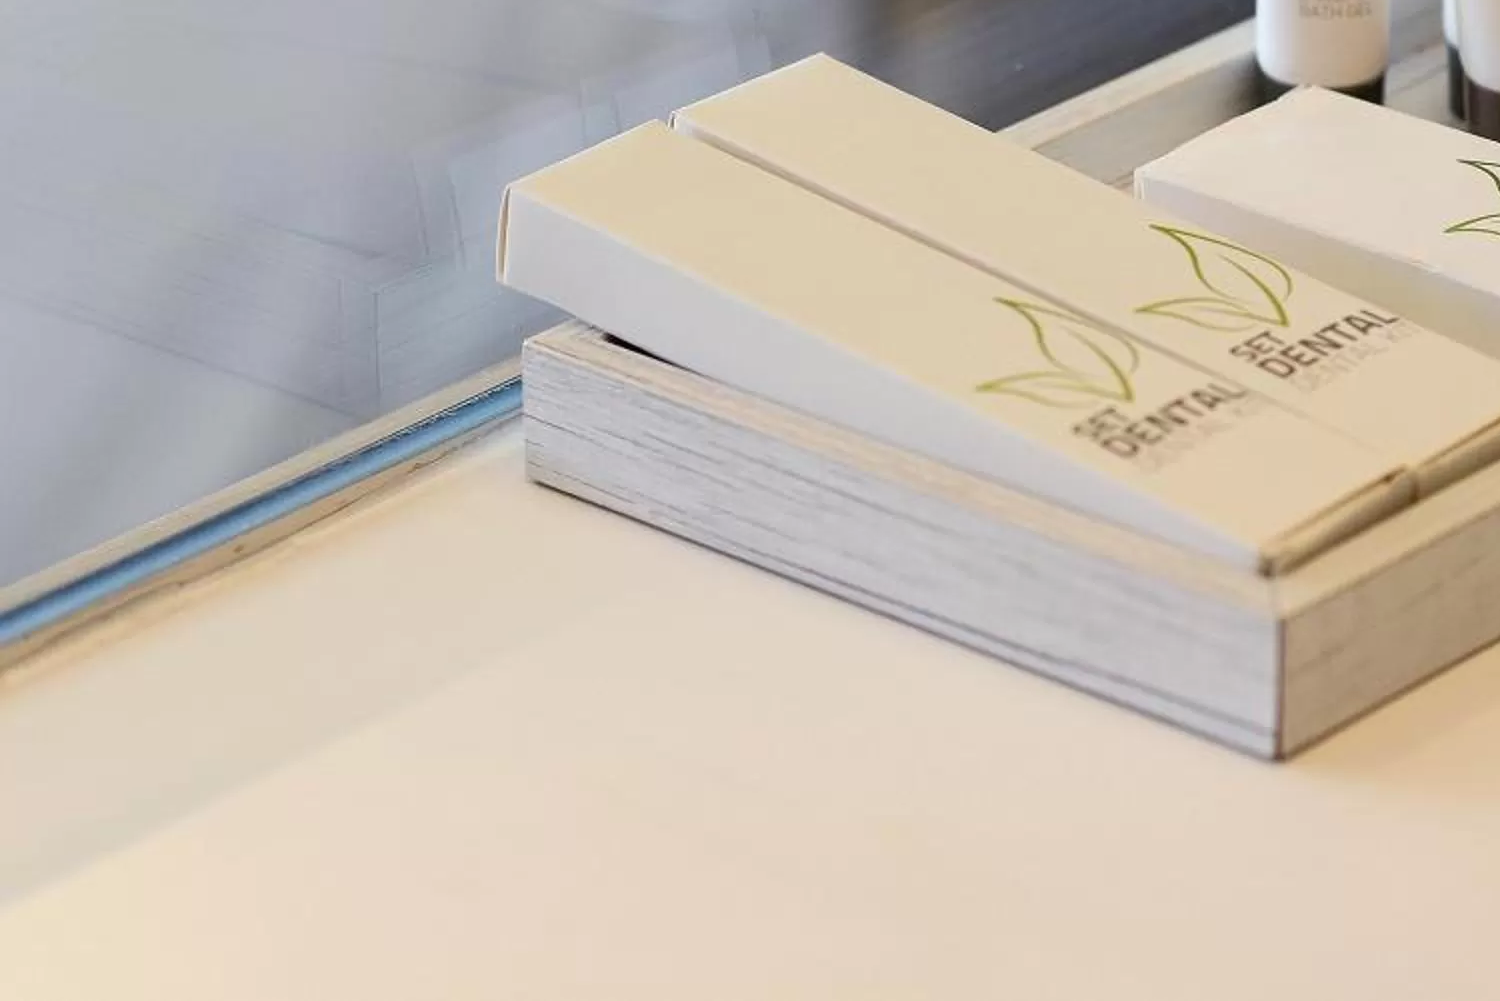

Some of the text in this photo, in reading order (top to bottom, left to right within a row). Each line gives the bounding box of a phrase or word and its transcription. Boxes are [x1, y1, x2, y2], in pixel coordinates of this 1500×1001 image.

[1229, 330, 1285, 362] SET
[1256, 309, 1400, 379] DENTAL
[1071, 405, 1130, 441] SET
[1100, 383, 1249, 458] DENTAL
